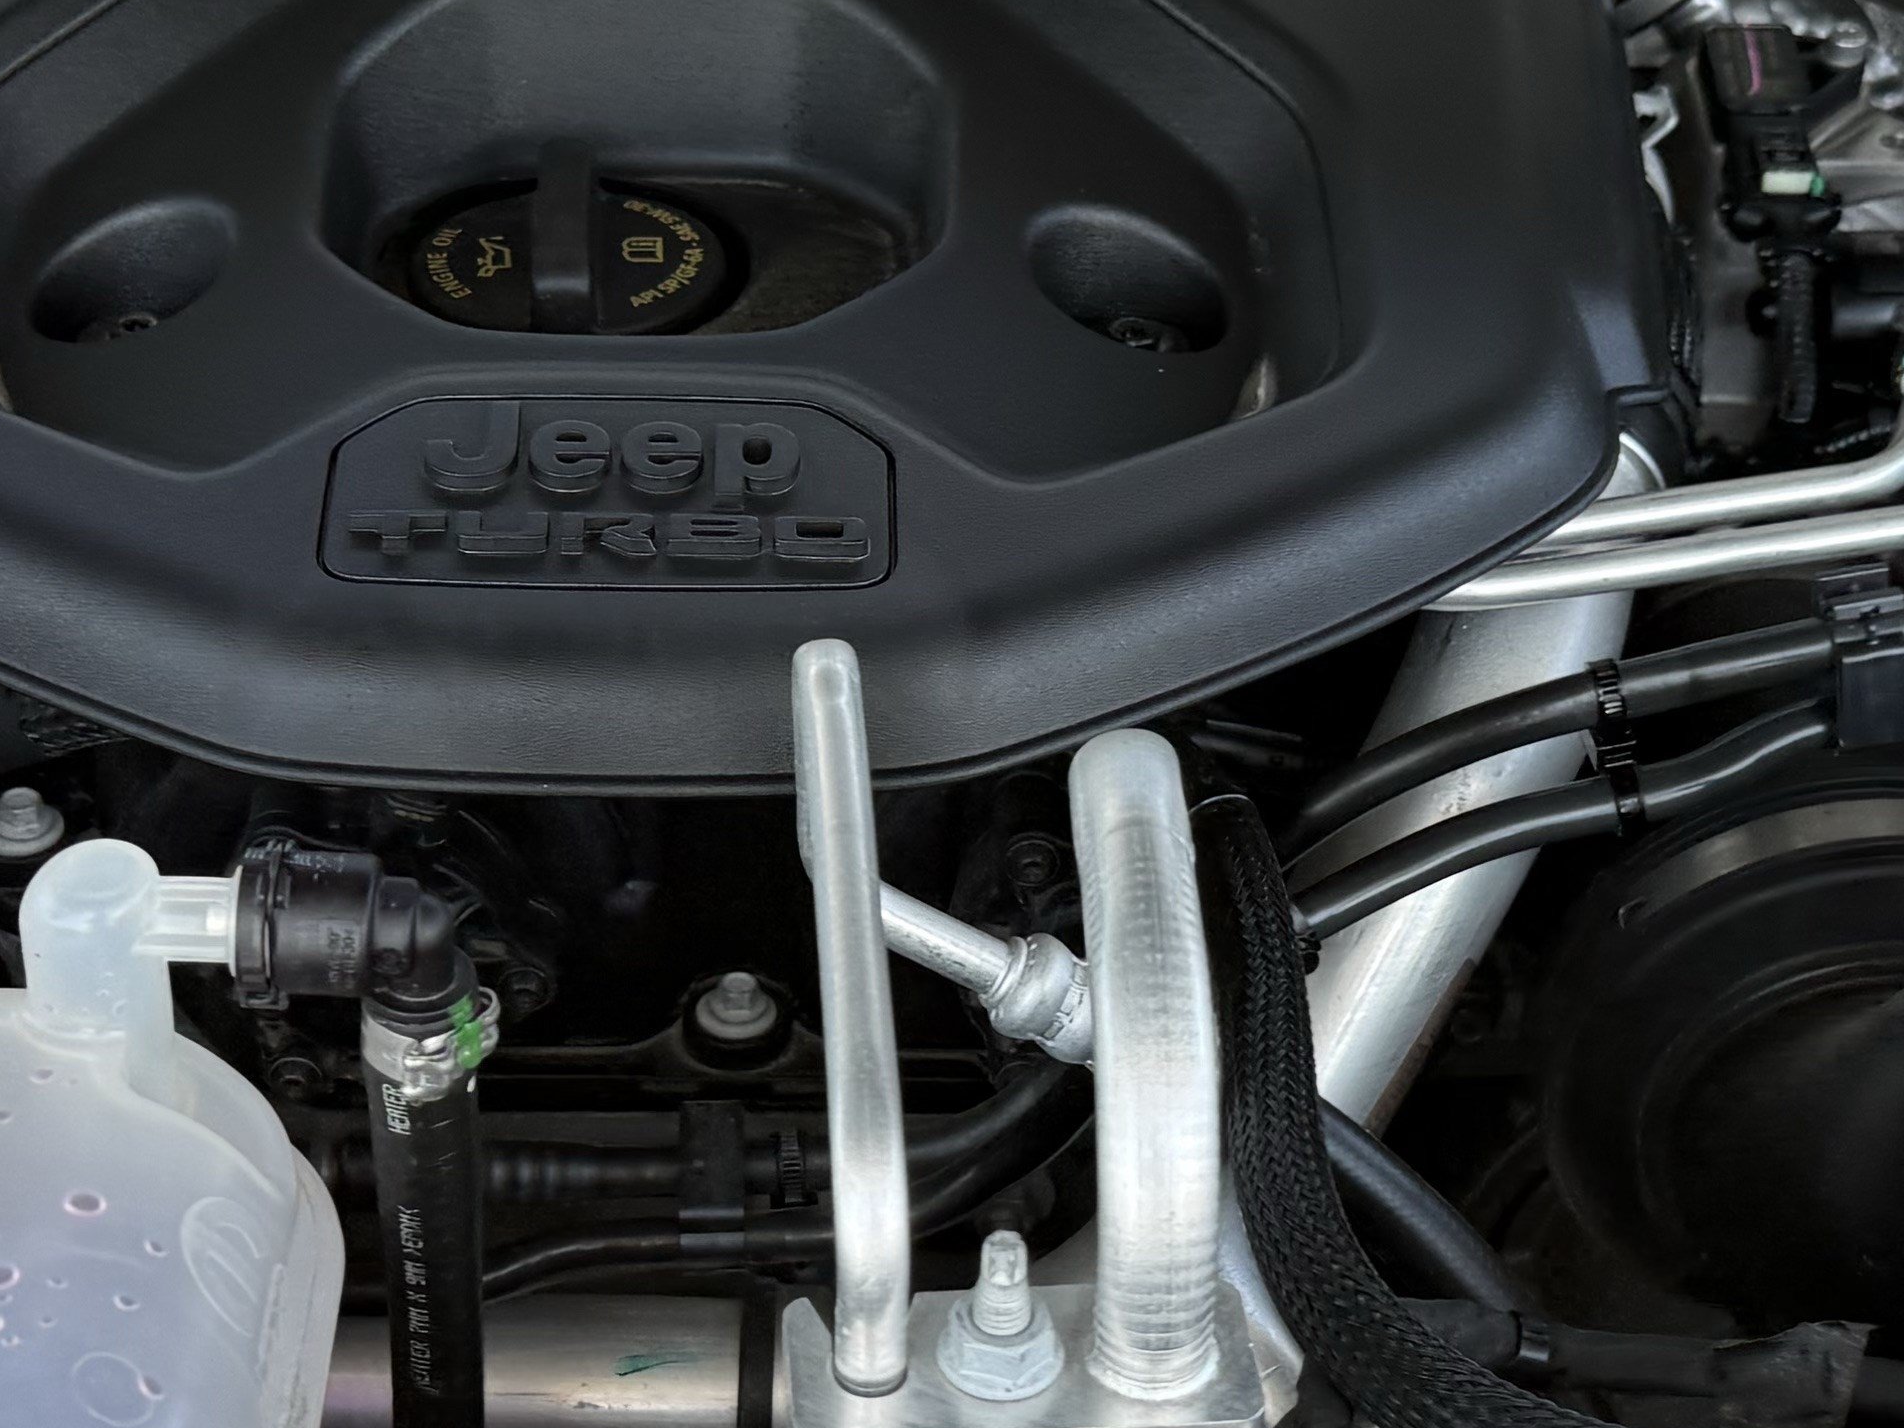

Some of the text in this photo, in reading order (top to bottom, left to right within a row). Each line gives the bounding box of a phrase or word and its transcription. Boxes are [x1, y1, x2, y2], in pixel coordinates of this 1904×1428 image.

[426, 227, 473, 300] ENGINE OIL
[423, 401, 802, 512] Jeep
[347, 510, 872, 563] TURBO
